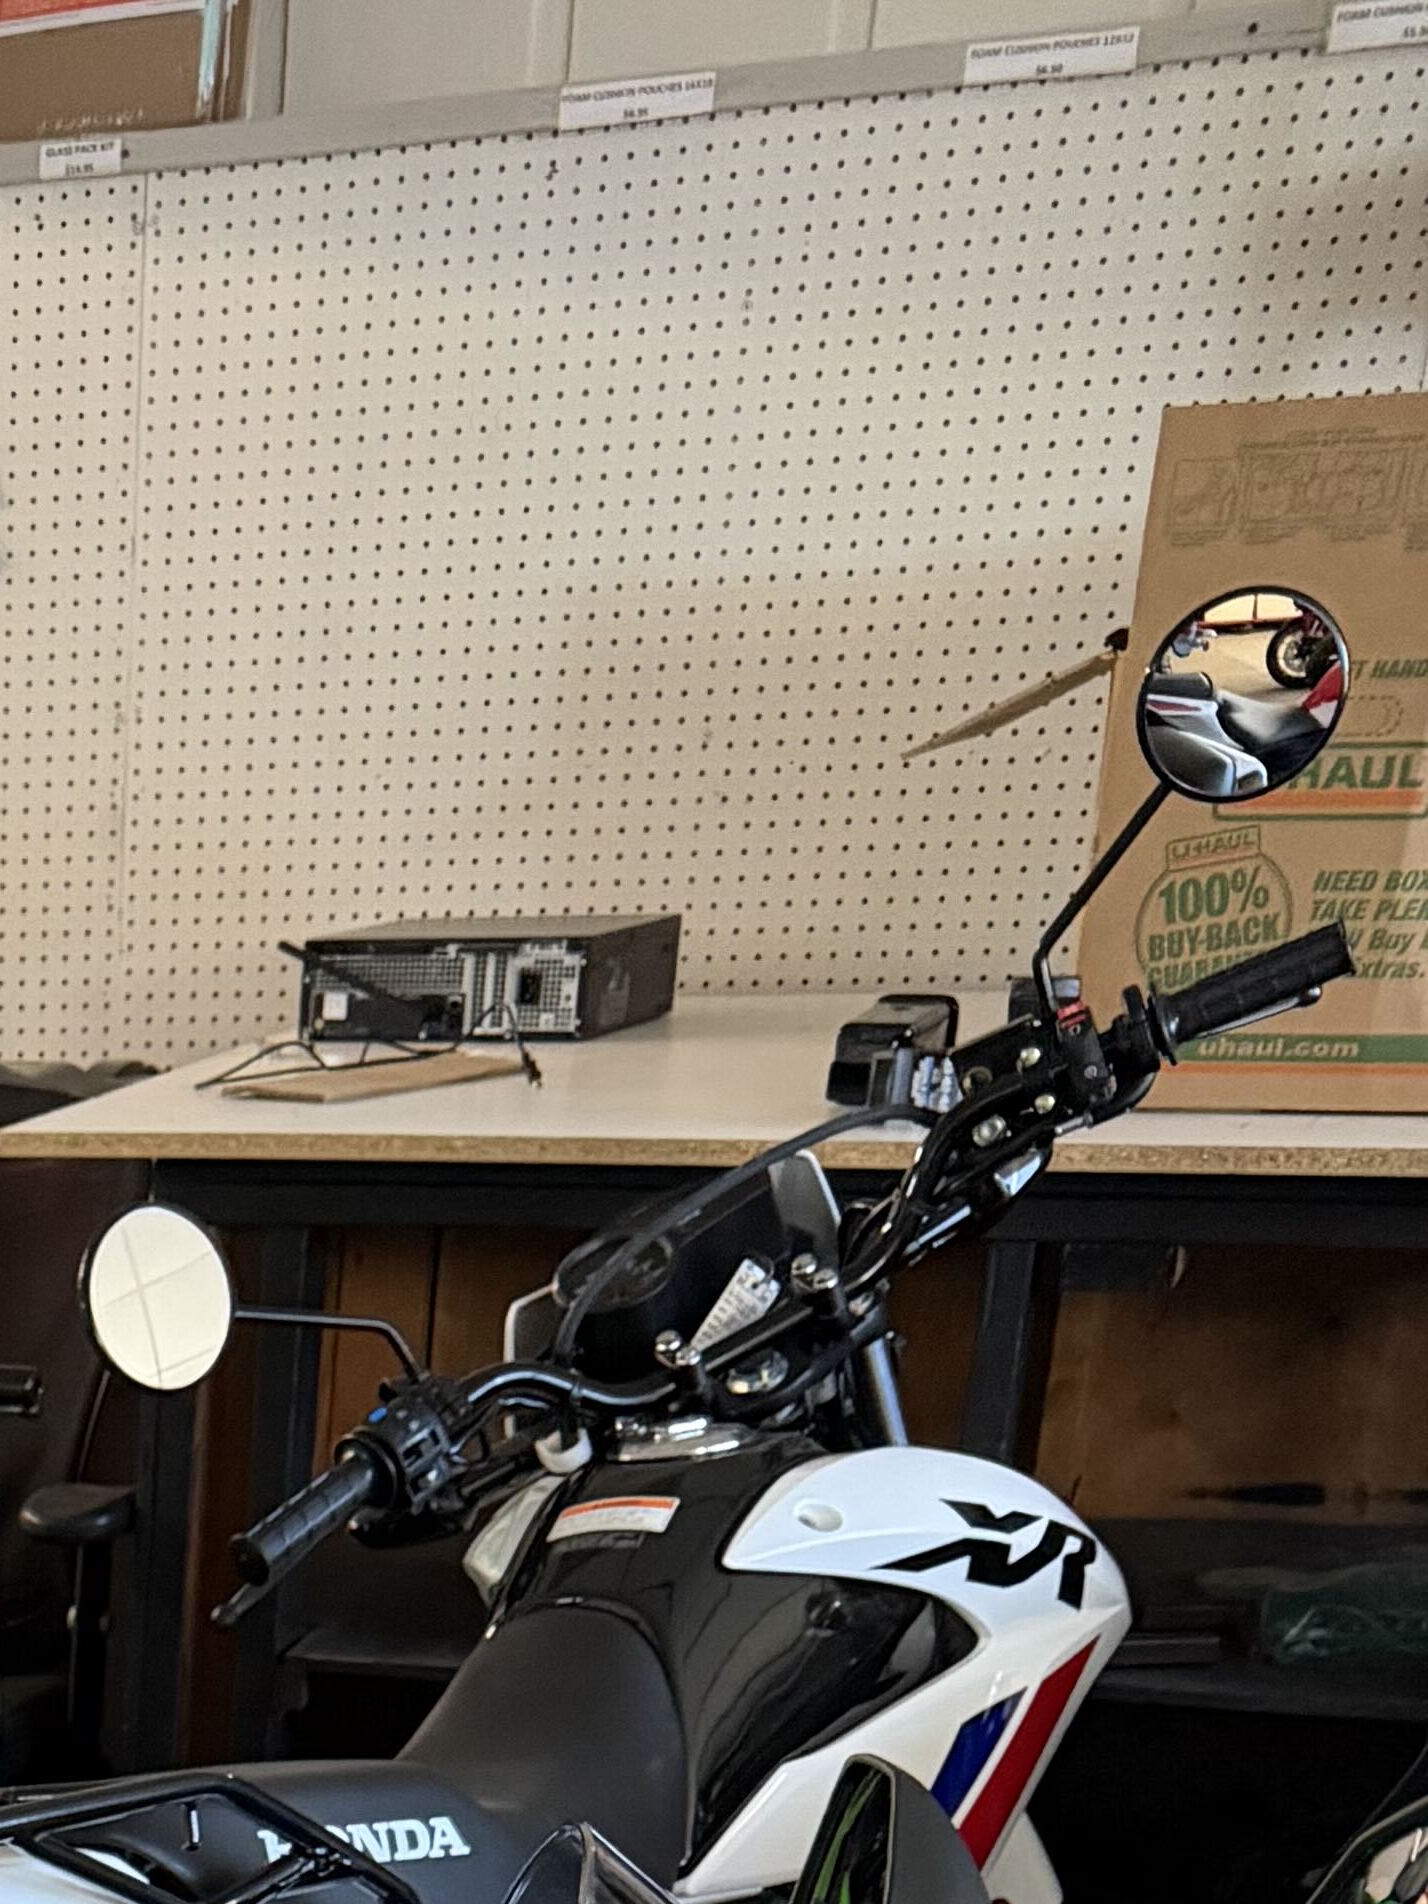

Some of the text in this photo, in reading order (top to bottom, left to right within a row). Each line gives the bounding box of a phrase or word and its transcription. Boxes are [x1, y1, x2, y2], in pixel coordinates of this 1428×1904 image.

[1158, 864, 1270, 926] 100%
[1313, 869, 1379, 893] NEED
[1310, 899, 1368, 922] TAKE
[1148, 912, 1281, 963] BUY-BACK
[1369, 927, 1417, 957] Buy
[1198, 1037, 1361, 1059] uhaul.com
[256, 1815, 472, 1865] HNDA
